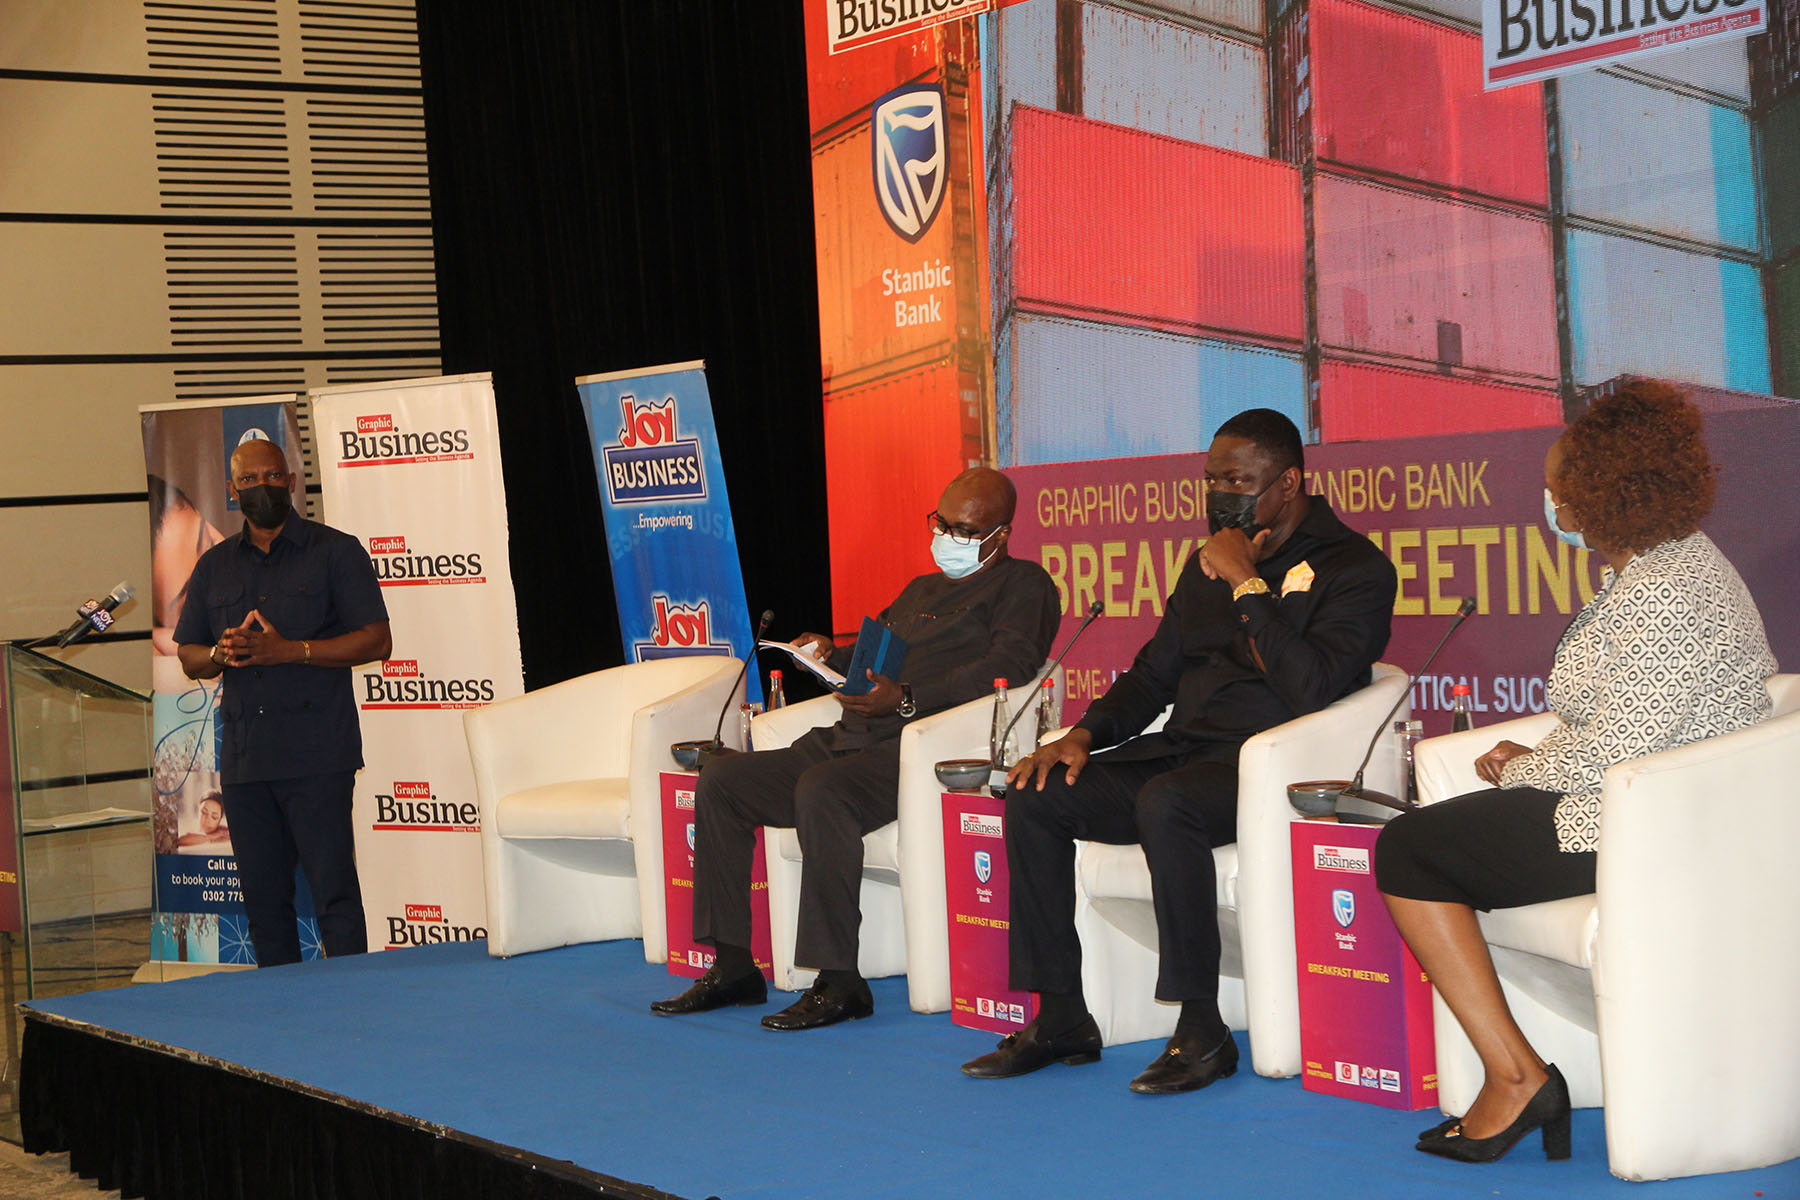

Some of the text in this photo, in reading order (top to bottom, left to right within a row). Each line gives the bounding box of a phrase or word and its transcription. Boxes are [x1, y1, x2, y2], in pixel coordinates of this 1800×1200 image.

[838, 0, 975, 39] Busin
[1498, 0, 1746, 59] Busin
[882, 258, 952, 296] Stanbic
[895, 294, 942, 327] Bank
[358, 416, 392, 432] Graphic
[622, 401, 674, 448] JOY
[339, 426, 469, 460] Business
[612, 455, 699, 489] BUSINESS
[1037, 482, 1138, 528] GRAPHIC
[1304, 466, 1396, 512] ANBIC
[1405, 460, 1491, 510] BANK
[371, 538, 405, 552] Graphic
[1041, 524, 1608, 618] BREAK EETIN
[97, 609, 115, 625] JOY
[655, 601, 708, 647] JOY
[383, 662, 417, 676] Graphic
[363, 672, 495, 702] Business
[1493, 676, 1555, 713] SUC
[394, 783, 429, 798] Graphic
[374, 794, 481, 824] Busine
[963, 819, 1001, 835] Business
[207, 859, 238, 871] Call us
[1317, 853, 1368, 870] Business
[171, 873, 181, 885] to
[183, 873, 204, 885] book
[205, 876, 226, 888] your
[202, 890, 225, 902] 0302
[406, 906, 441, 920] Graphic
[956, 913, 989, 928] BREAKFAST
[1335, 931, 1358, 943] Stanbic
[1338, 941, 1355, 951] Bank
[1307, 962, 1391, 984] BREAKFAST MEETING
